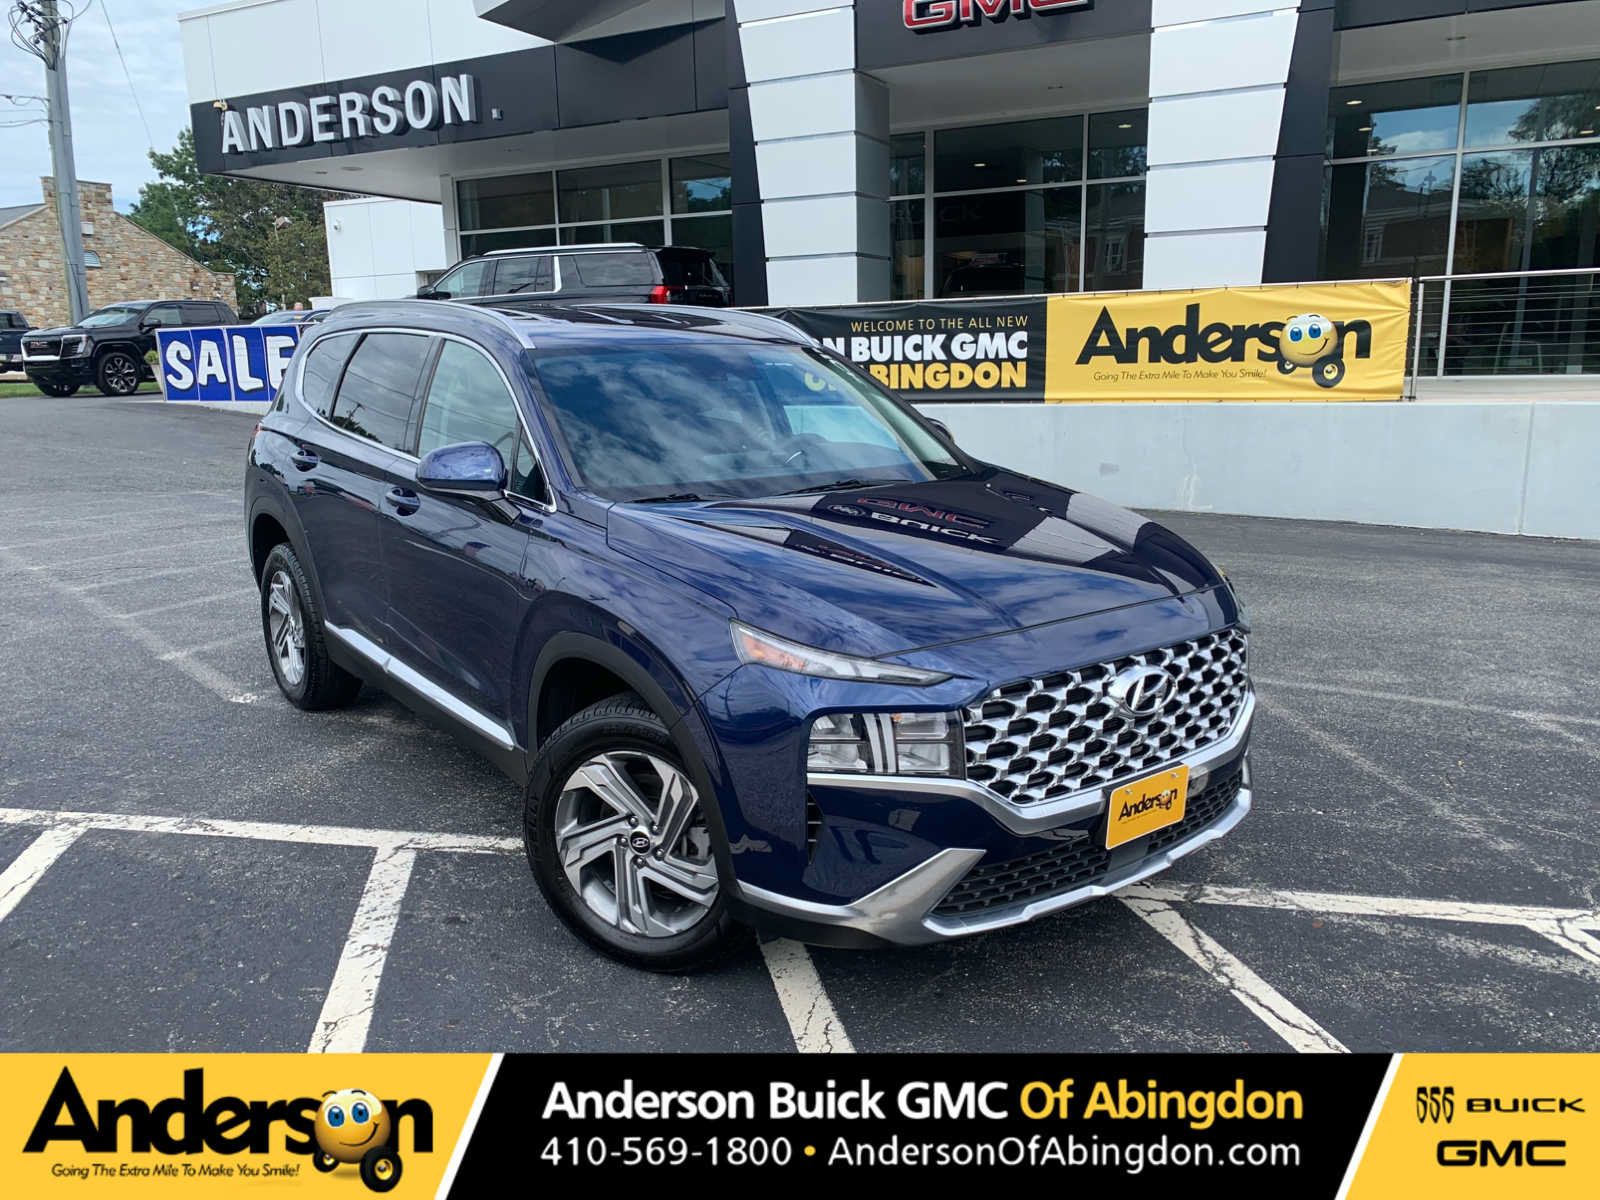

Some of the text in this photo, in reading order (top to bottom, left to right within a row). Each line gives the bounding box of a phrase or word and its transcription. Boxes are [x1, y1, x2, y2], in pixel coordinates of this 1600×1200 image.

[222, 74, 474, 153] ANDERSON
[851, 315, 1028, 333] WELCOME TO THE ALL NEW
[851, 333, 948, 363] BUICK
[951, 331, 1028, 361] GMC
[166, 334, 297, 392] SALE
[869, 361, 1027, 390] BINGDON
[1093, 368, 1267, 382] Going The Extra Mile To Make You Smile!
